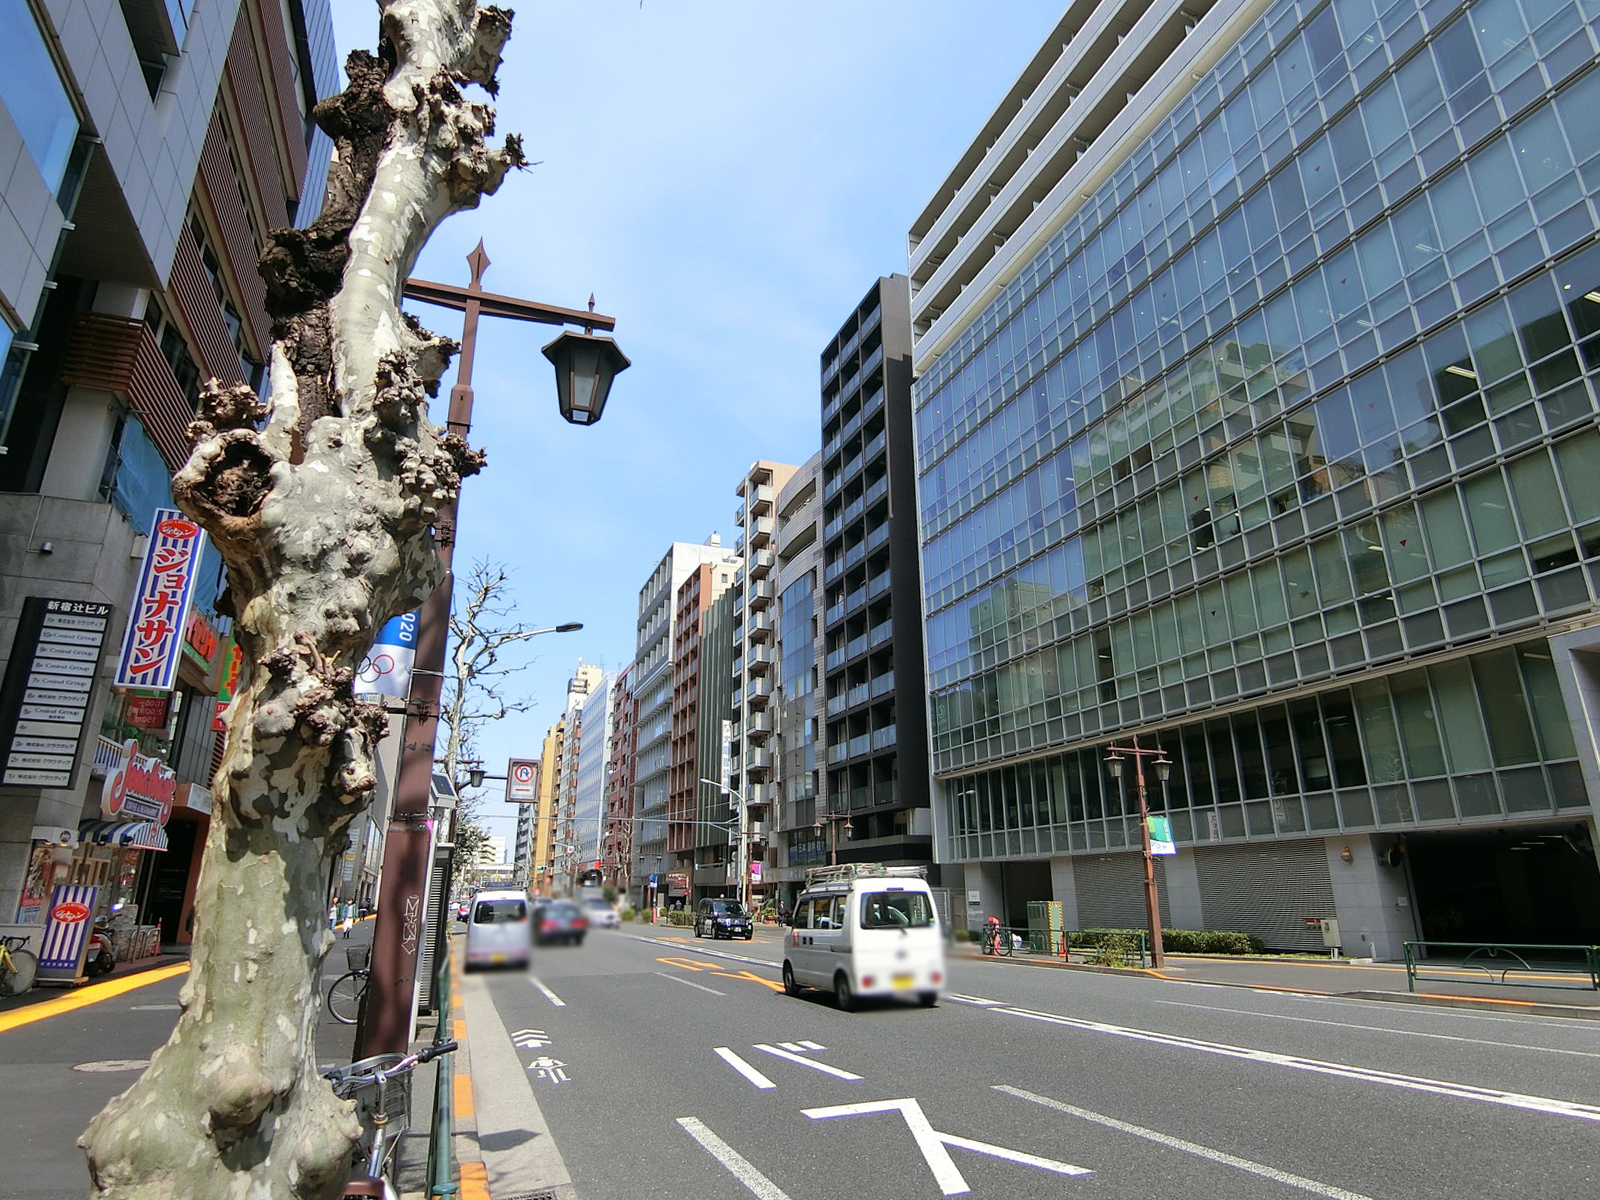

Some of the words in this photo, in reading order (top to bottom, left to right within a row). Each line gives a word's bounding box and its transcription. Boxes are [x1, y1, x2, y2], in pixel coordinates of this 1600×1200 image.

[47, 600, 109, 615] 新宿辻ビル
[129, 548, 189, 675] ジョナサン
[399, 610, 416, 642] 020
[77, 634, 98, 642] Group
[73, 649, 94, 657] Group
[69, 664, 90, 672] Group
[65, 680, 87, 688] Group
[58, 709, 80, 717] Group
